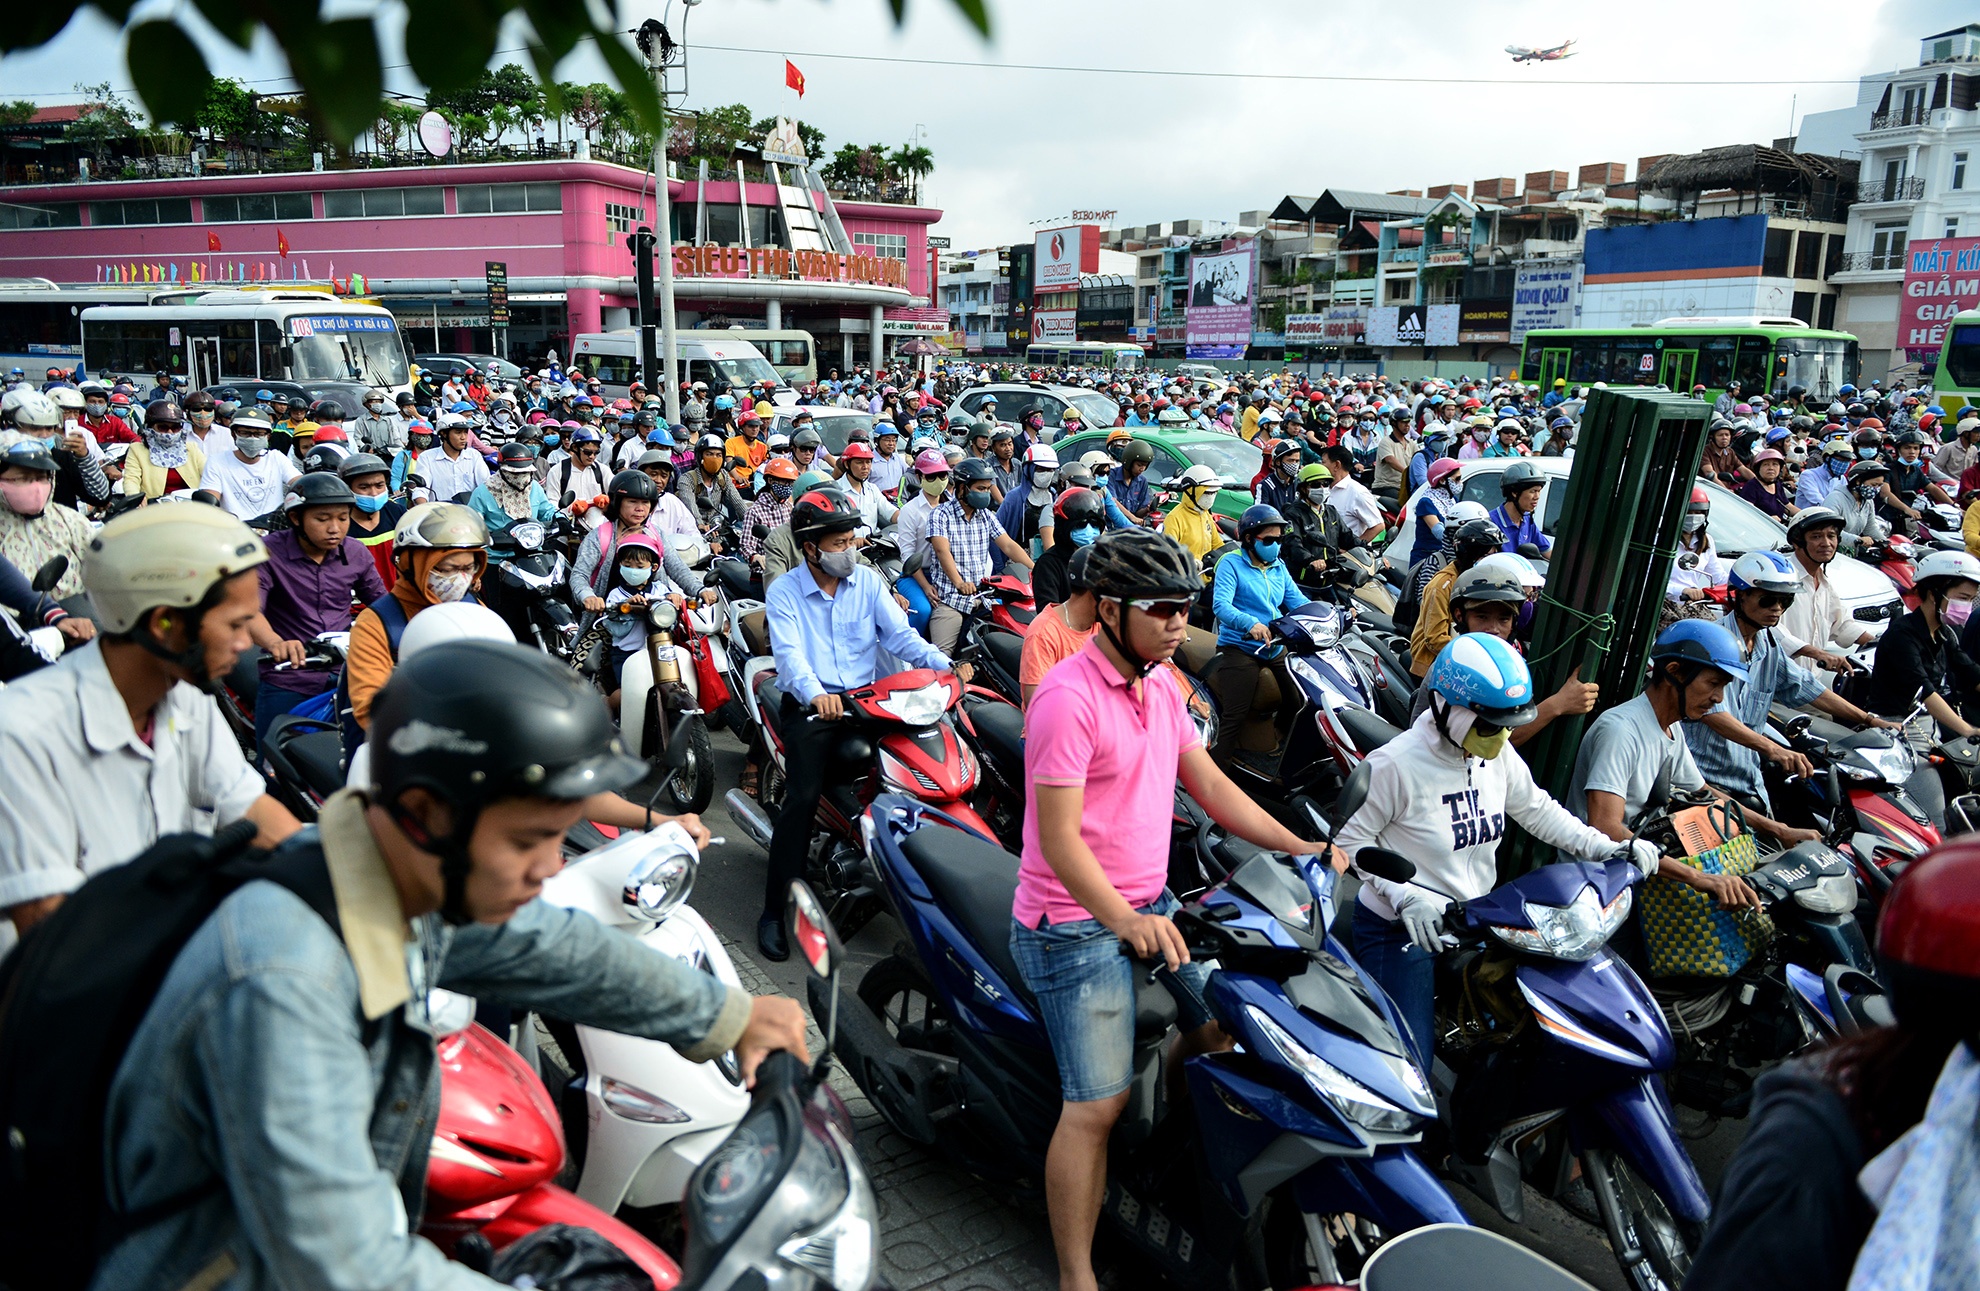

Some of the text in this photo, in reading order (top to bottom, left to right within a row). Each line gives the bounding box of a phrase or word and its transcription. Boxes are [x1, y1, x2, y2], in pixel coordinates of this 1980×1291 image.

[1072, 210, 1118, 220] BIBO MART
[928, 238, 949, 246] WATCH
[676, 243, 739, 275] SIÊU
[746, 248, 790, 280] THỊ
[796, 247, 841, 278] VĂN
[846, 251, 881, 283] HÓA
[1912, 241, 1952, 273] MẮT
[1043, 263, 1071, 277] BIBO MART
[1908, 274, 1979, 297] GIẢM
[1516, 284, 1569, 307] MINH QUÂN
[1620, 298, 1675, 322] BIDV
[1916, 300, 1959, 321] GIÁ
[292, 318, 312, 336] 103
[312, 319, 322, 329] BX
[323, 319, 336, 331] CHỢ
[336, 317, 349, 329] LỚN
[355, 319, 363, 329] BX
[364, 318, 376, 329] NGÃ
[376, 319, 381, 329] 4
[381, 320, 390, 329] GA
[900, 321, 914, 330] KEM
[914, 322, 927, 330] VĂN
[927, 323, 944, 331] LANG
[1046, 318, 1075, 330] BIBO MART
[1397, 330, 1425, 339] adidas
[1909, 322, 1950, 345] HẾ
[1642, 356, 1652, 369] 03
[1452, 684, 1467, 697] Life
[1773, 849, 1842, 886] Blue Label
